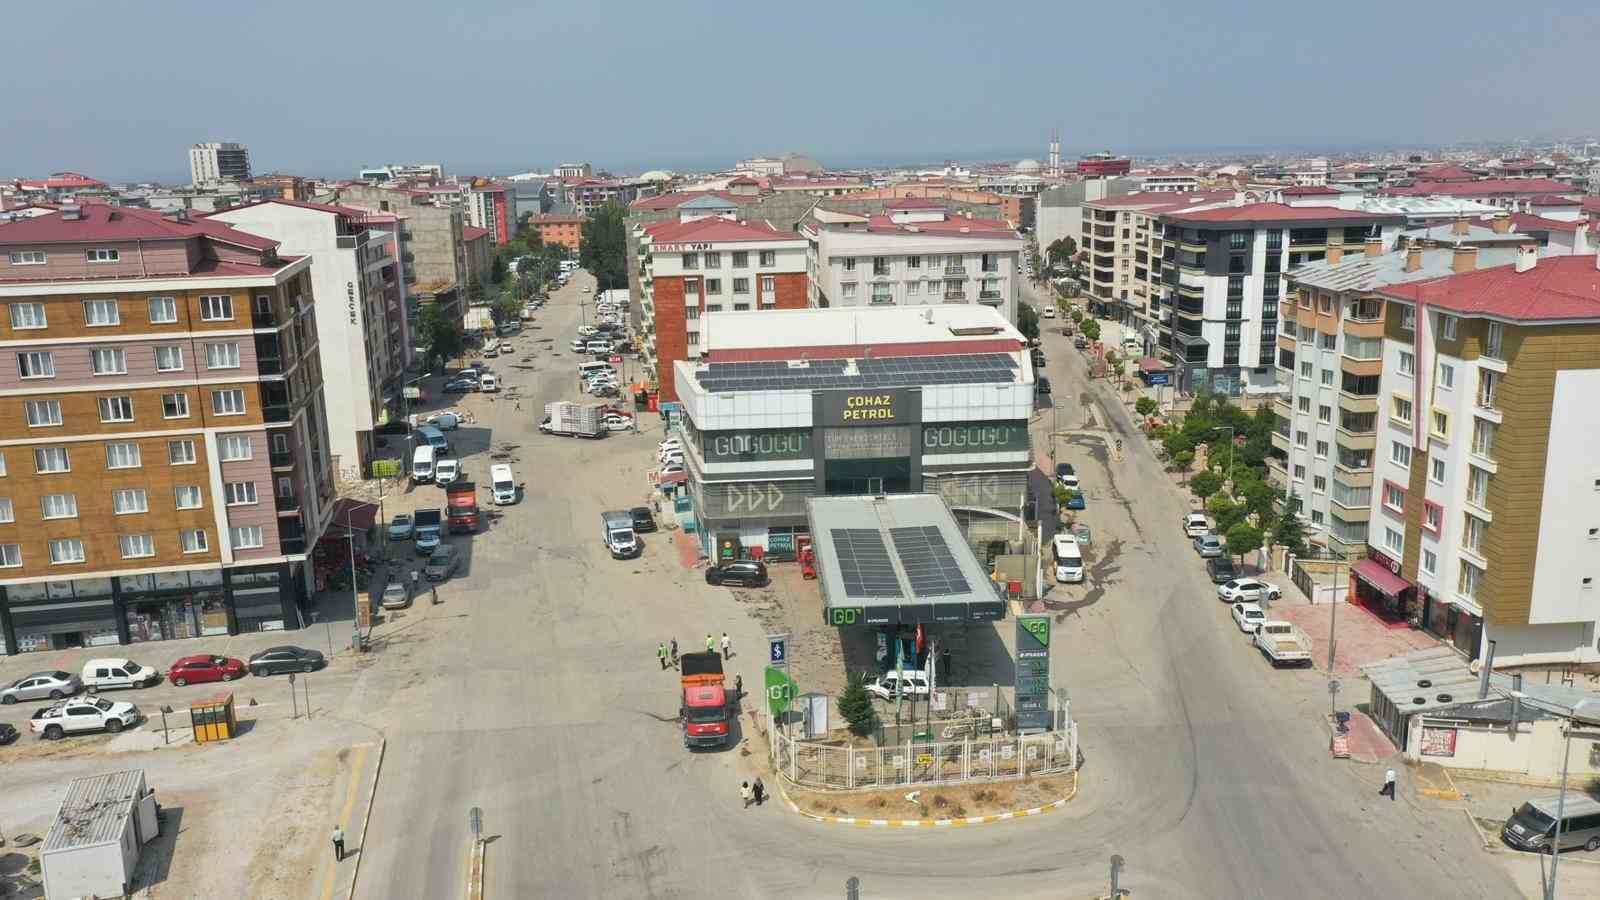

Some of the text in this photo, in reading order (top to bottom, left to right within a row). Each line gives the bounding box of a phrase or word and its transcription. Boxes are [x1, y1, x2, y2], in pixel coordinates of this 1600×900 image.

[655, 242, 687, 252] SMART
[847, 395, 891, 408] ÇOHAZ
[843, 408, 895, 420] PETROL
[924, 427, 1009, 447] GOGOGO
[833, 609, 856, 625] GO
